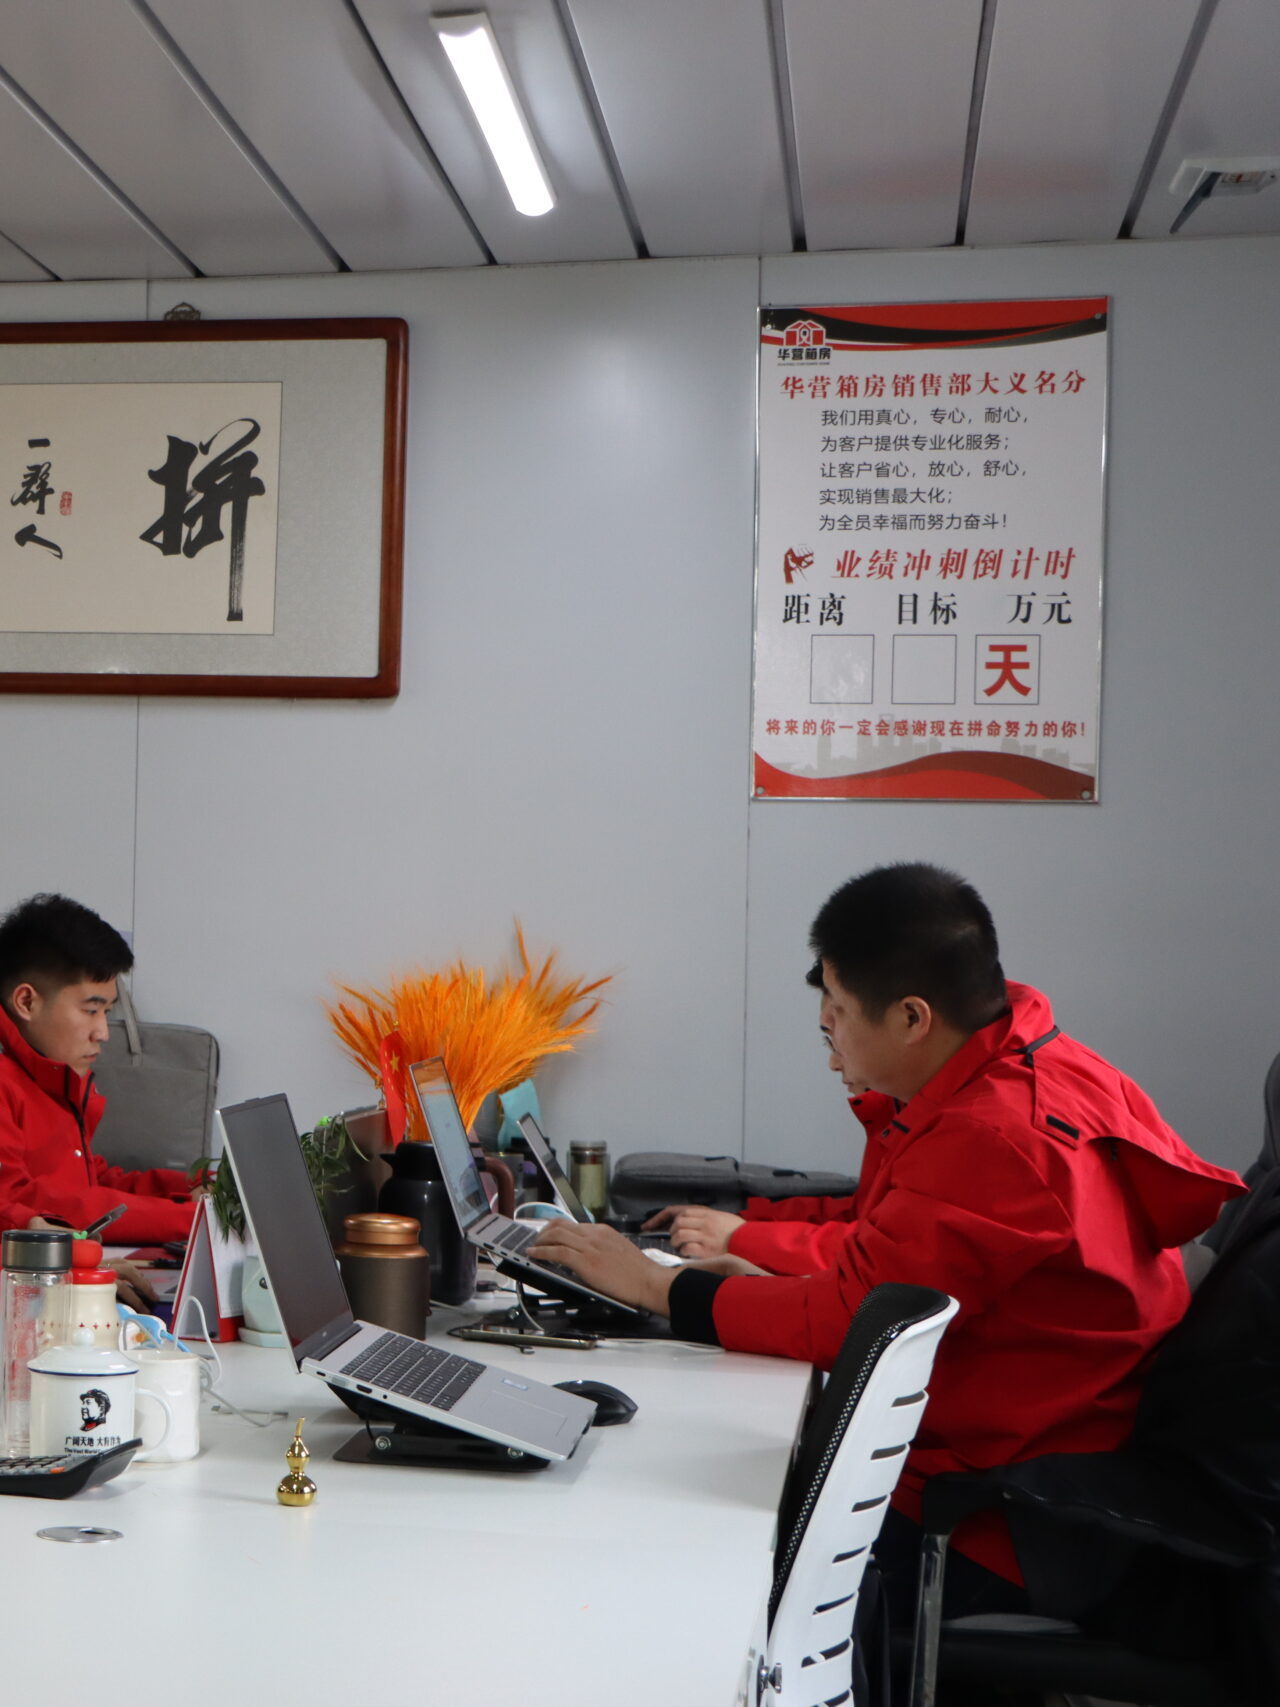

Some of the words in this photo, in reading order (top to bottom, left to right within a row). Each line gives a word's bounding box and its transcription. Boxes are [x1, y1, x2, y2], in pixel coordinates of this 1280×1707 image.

[777, 347, 831, 361] 华营箱房
[781, 370, 1086, 399] 华营箱房销售部大义名分
[139, 417, 266, 622] 拼
[832, 547, 1076, 581] 业绩冲刺倒计时
[782, 592, 846, 626] 距离
[897, 591, 957, 625] 目标
[1007, 591, 1072, 625] 万元
[983, 644, 1031, 697] 天
